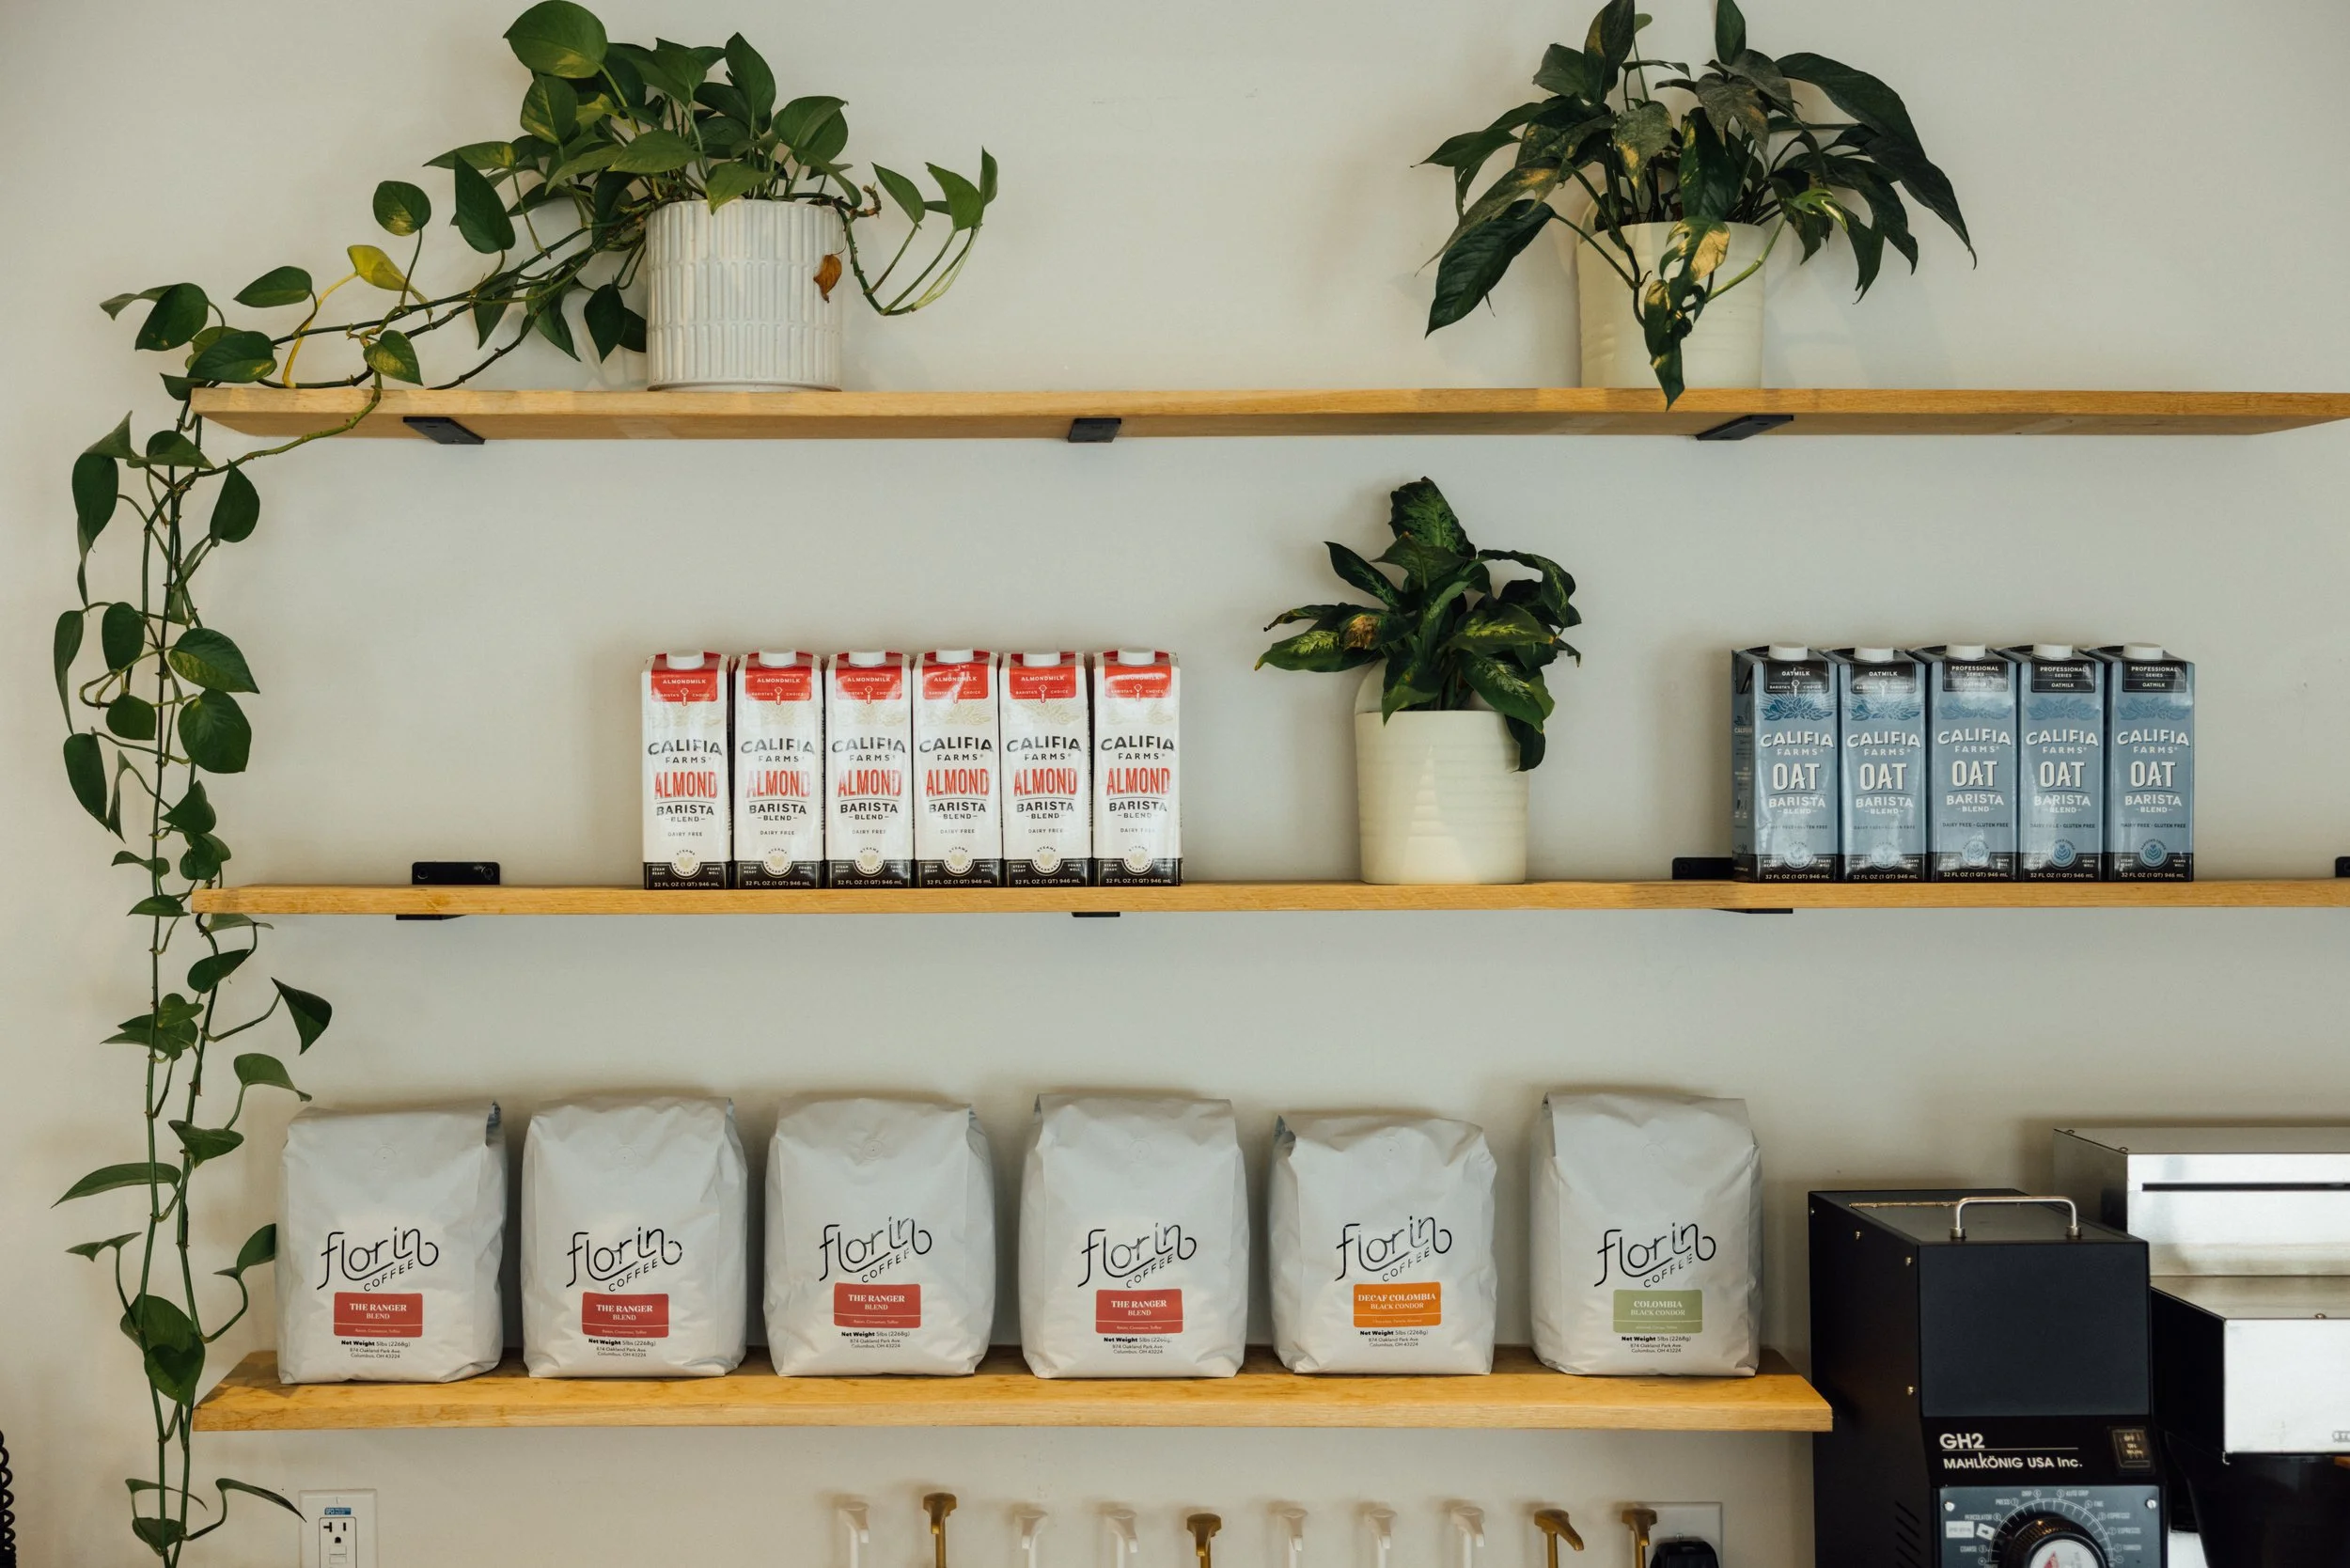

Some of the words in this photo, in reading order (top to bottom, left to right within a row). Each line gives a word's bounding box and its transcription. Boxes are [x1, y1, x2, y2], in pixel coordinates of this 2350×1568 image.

[832, 737, 905, 753] CALIFIA
[919, 736, 993, 753] CALIFIA
[1007, 736, 1081, 752] CALIFIA
[1101, 735, 1174, 751] CALIFIA
[1760, 731, 1834, 748] CALIFIA
[1847, 731, 1920, 747] CALIFIA
[1937, 729, 2011, 745] CALIFIA
[2026, 729, 2098, 746] CALIFIA
[2117, 729, 2189, 746] CALIFIA
[648, 738, 722, 755] CALIFIA
[741, 738, 815, 754] CALIFIA
[926, 768, 989, 796] ALMOND
[1014, 767, 1077, 795] ALMOND
[1106, 767, 1170, 795] ALMOND
[1772, 763, 1821, 791] OAT
[1859, 763, 1908, 791] OAT
[1951, 760, 1998, 788] OAT
[2040, 760, 2086, 788] OAT
[2130, 760, 2176, 788] OAT
[655, 771, 717, 798] ALMOND
[746, 770, 810, 797] ALMOND
[838, 769, 901, 797] ALMOND
[840, 802, 898, 814] BARISTA
[929, 801, 986, 813] BARISTA
[1016, 801, 1073, 813] BARISTA
[1109, 801, 1167, 811] BARISTA
[1769, 796, 1825, 808] BARISTA
[1856, 796, 1914, 808] BARISTA
[1946, 794, 2004, 806] BARISTA
[2034, 794, 2092, 807] BARISTA
[2125, 795, 2182, 807] BARISTA
[657, 805, 714, 816] BARISTA
[749, 804, 807, 815] BARISTA
[819, 1216, 932, 1281] florin
[1077, 1223, 1197, 1288] florin
[1335, 1215, 1452, 1281] florin
[1594, 1222, 1716, 1287] florin
[317, 1226, 439, 1291] florin
[566, 1226, 682, 1288] florin
[1382, 1247, 1430, 1281] COFFEE
[364, 1259, 414, 1292] COFFEE
[609, 1258, 657, 1292] COFFEE
[1126, 1254, 1173, 1288] COFFEE
[350, 1303, 368, 1311] THE
[596, 1304, 614, 1312] THE
[1939, 1433, 1984, 1450] GH2
[2028, 1456, 2054, 1467] USA
[2058, 1457, 2083, 1467] Inc.
